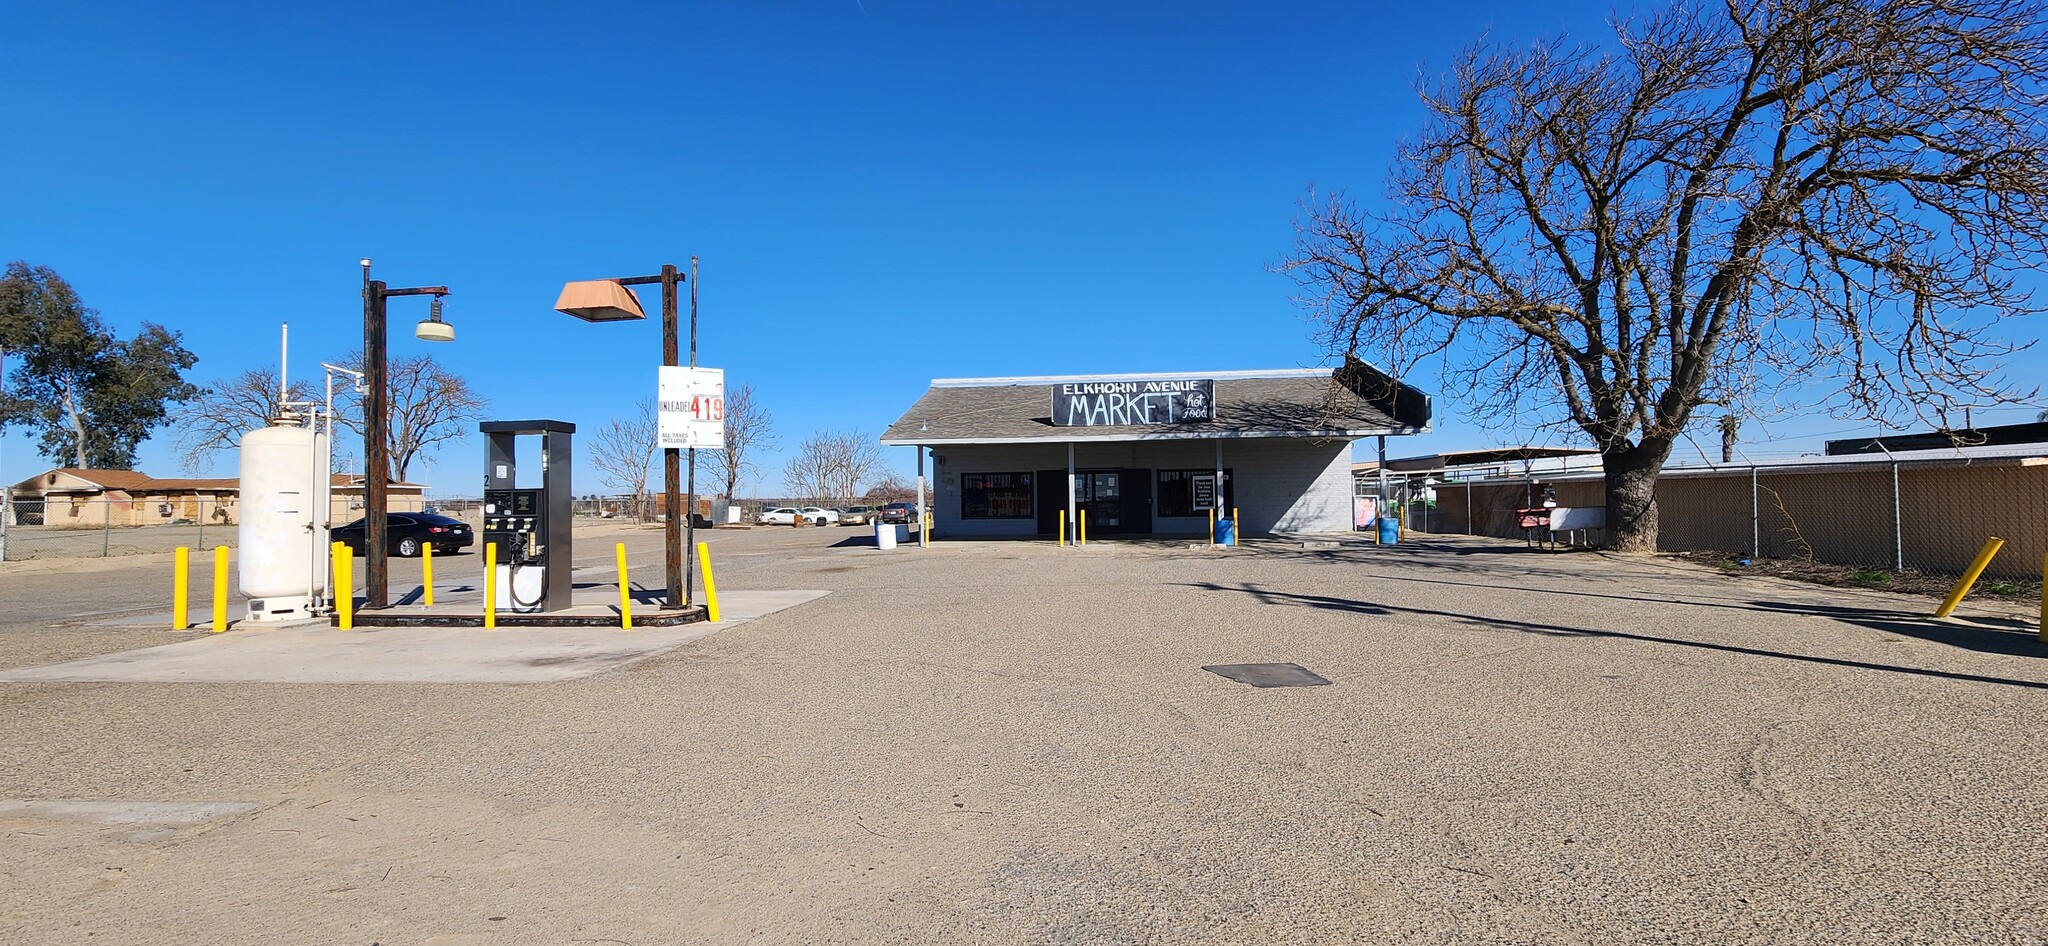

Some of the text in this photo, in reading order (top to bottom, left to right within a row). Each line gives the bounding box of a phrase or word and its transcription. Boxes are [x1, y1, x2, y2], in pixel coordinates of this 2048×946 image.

[1063, 380, 1199, 395] ELKHORN AVENUE
[691, 395, 723, 420] 419
[1183, 393, 1205, 407] hot
[1067, 392, 1181, 426] MARKET
[484, 475, 489, 487] 2
